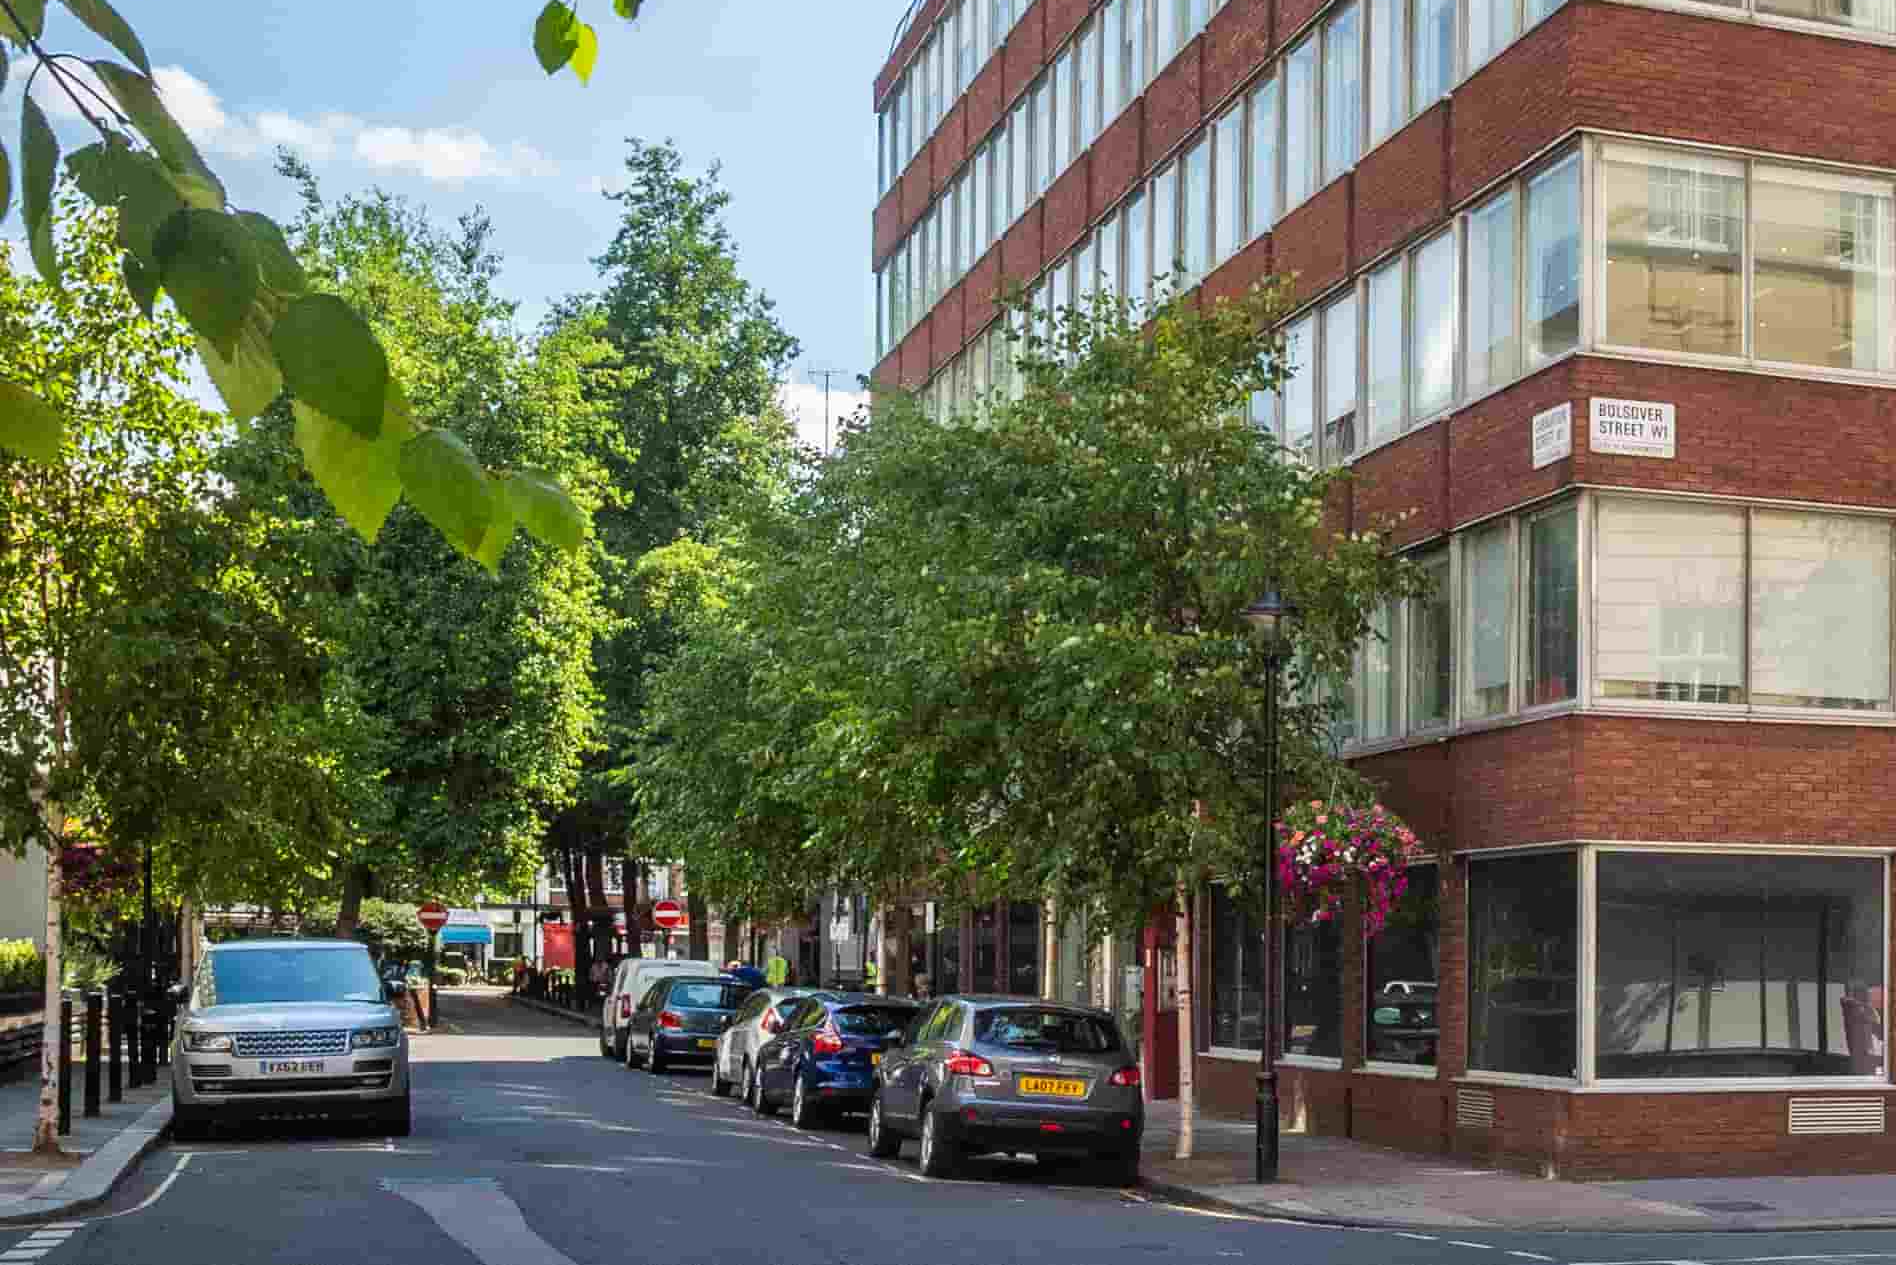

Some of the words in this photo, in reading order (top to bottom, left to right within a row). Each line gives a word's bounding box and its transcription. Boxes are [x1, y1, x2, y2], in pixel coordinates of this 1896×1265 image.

[1599, 403, 1664, 422] BOLSOVER
[1599, 421, 1644, 437] STREET
[1650, 425, 1669, 440] W1
